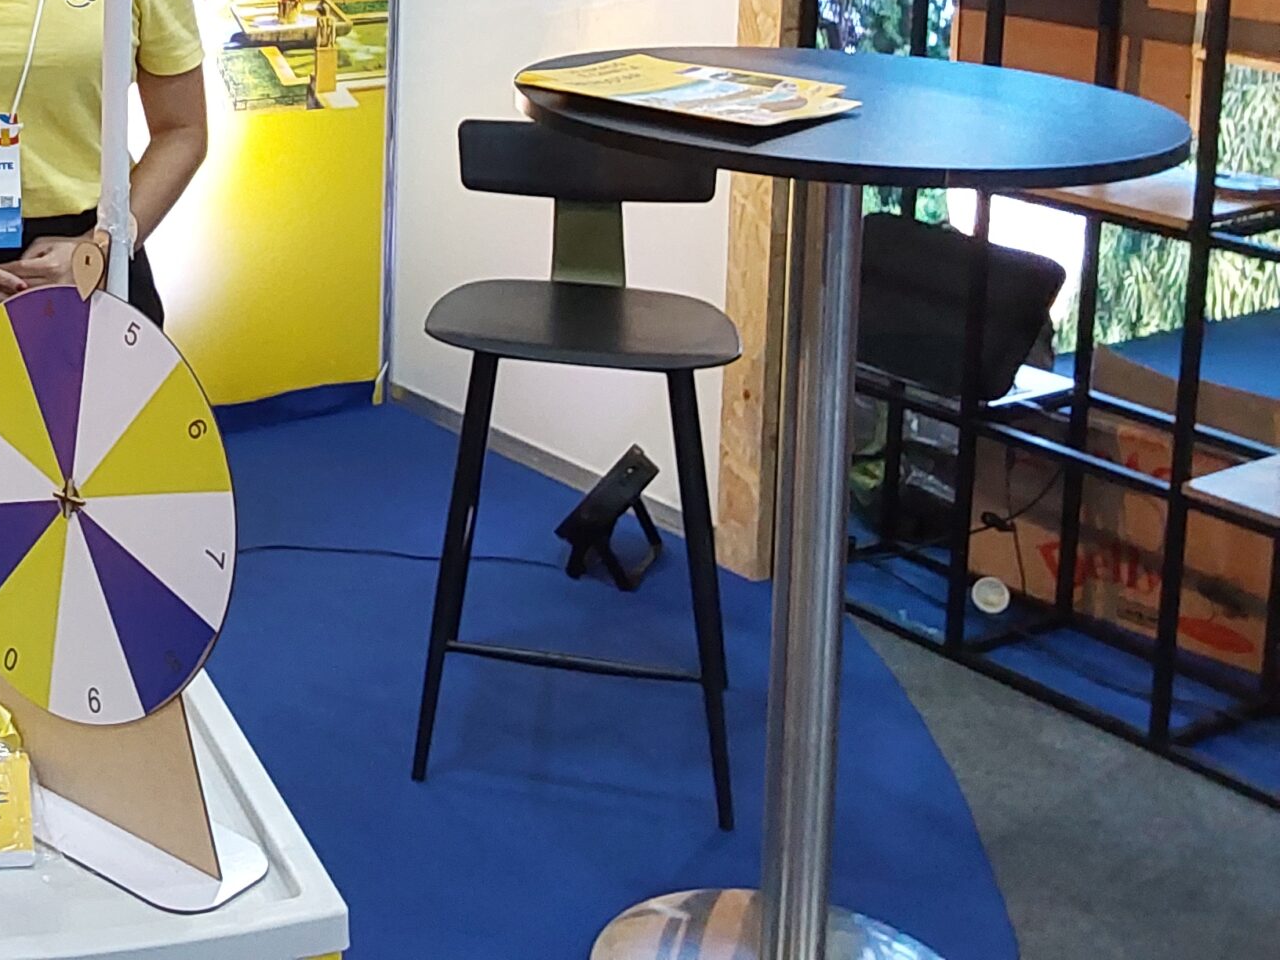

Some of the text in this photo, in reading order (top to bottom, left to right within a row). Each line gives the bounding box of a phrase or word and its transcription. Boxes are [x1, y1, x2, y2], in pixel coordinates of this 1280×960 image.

[124, 321, 141, 346] 5
[205, 549, 225, 570] 7
[4, 647, 18, 671] 0
